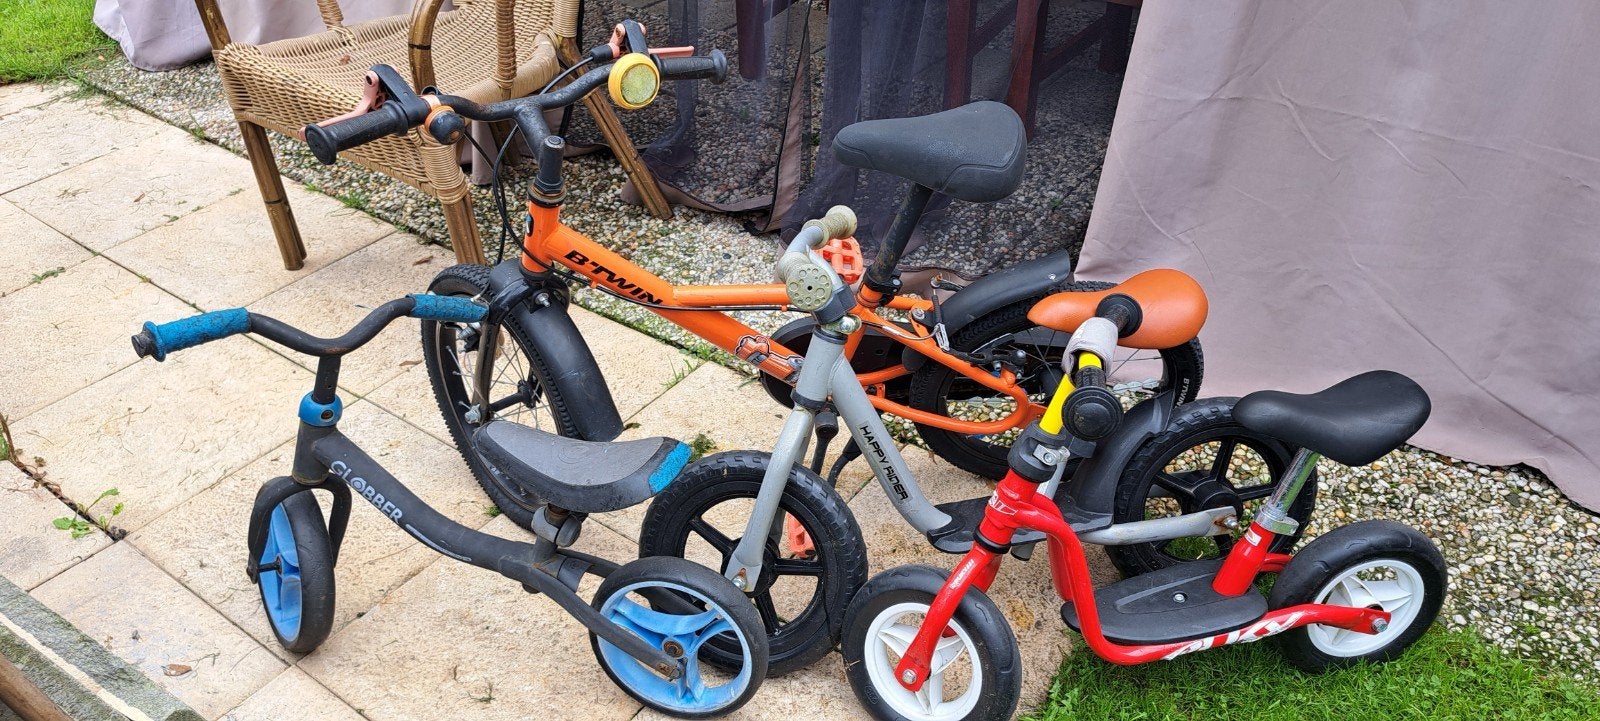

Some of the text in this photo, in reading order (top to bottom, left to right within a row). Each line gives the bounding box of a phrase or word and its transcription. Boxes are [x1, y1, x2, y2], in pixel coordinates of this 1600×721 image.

[564, 249, 664, 305] B'TWIN
[330, 460, 403, 524] GLOBBER
[860, 425, 909, 500] HAPPY RIDER
